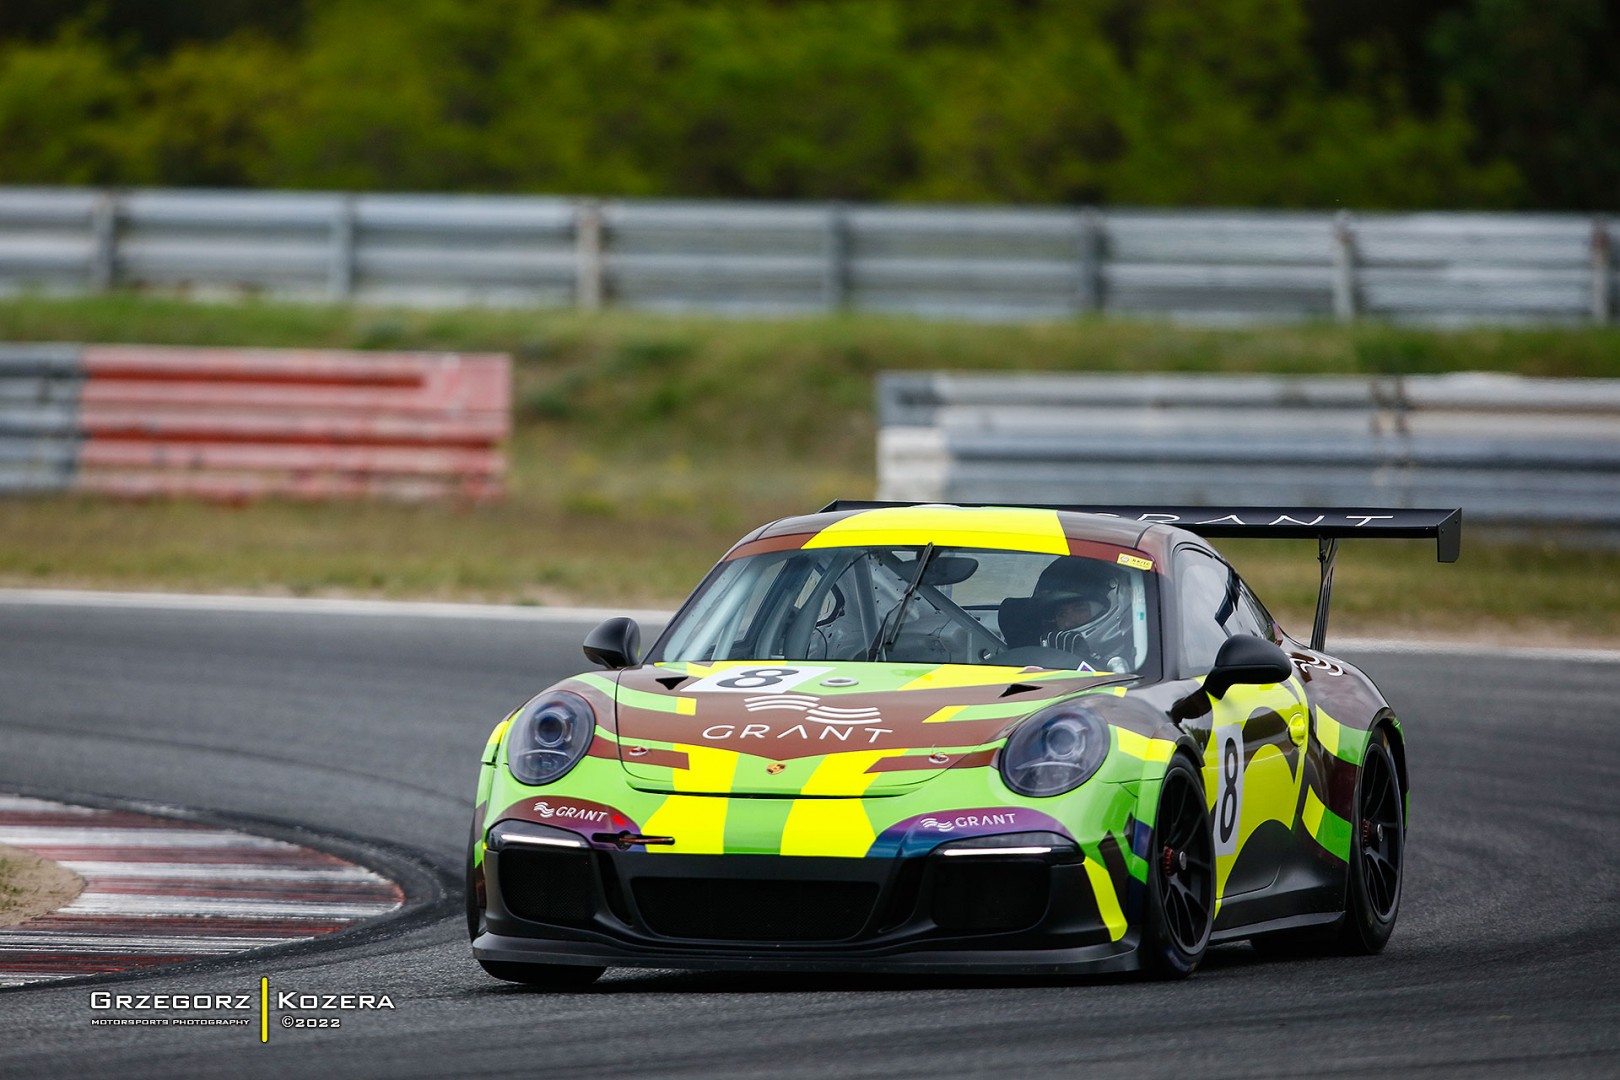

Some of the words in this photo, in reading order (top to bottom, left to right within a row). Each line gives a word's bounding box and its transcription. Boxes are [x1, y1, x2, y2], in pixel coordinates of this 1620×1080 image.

[1094, 512, 1394, 526] RANT
[716, 668, 800, 689] 8
[702, 724, 893, 743] GRANT
[1219, 737, 1239, 844] 8
[555, 806, 608, 822] GRANT
[954, 813, 1016, 828] GRANT
